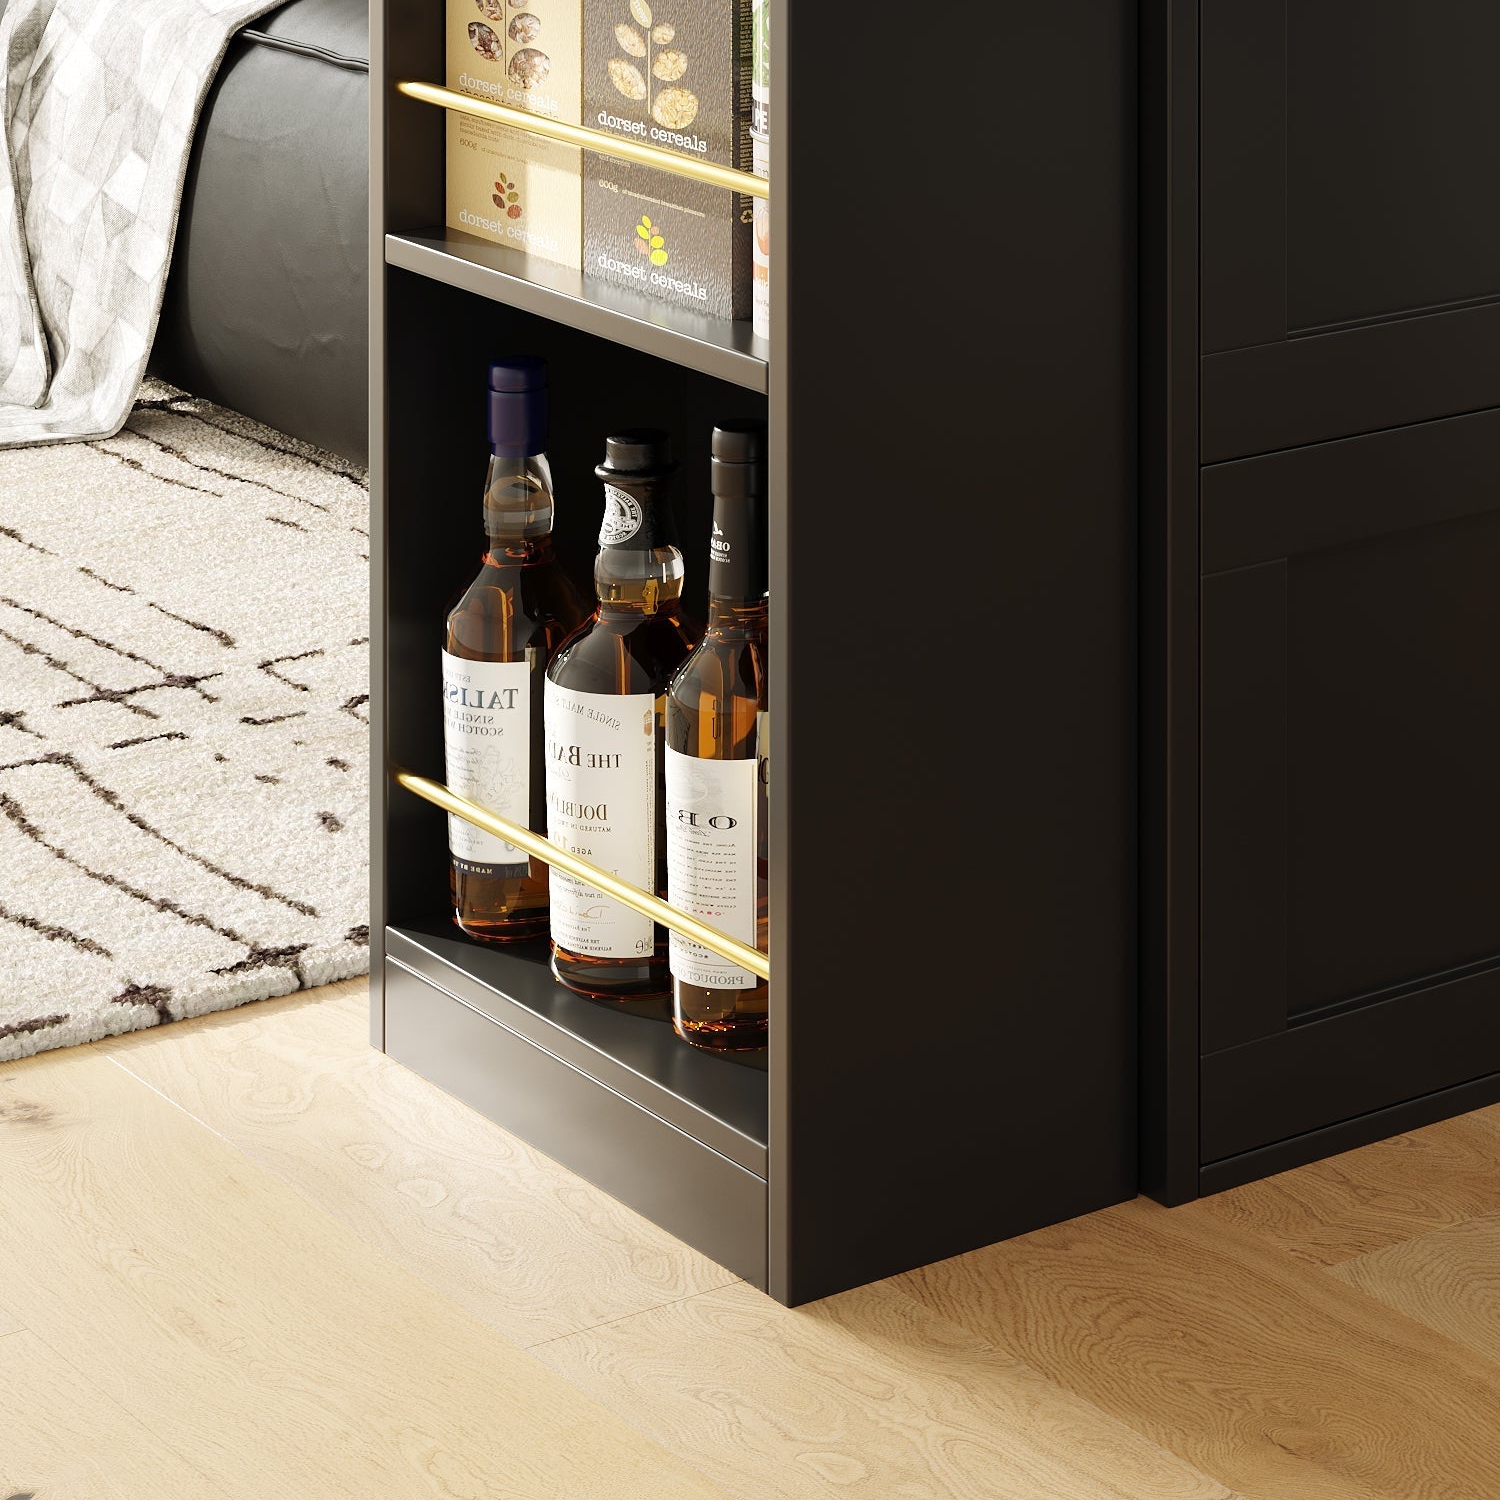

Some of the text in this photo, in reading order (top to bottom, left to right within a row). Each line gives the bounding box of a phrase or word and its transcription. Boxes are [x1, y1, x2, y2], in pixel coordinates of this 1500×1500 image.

[633, 0, 648, 22] new
[459, 73, 503, 96] dorset
[507, 87, 558, 111] cereals
[460, 138, 477, 151] 600g
[598, 110, 707, 153] dorset cereals
[598, 179, 619, 193] 600g
[459, 209, 559, 251] dorset cereals
[598, 253, 707, 300] dorset cereals
